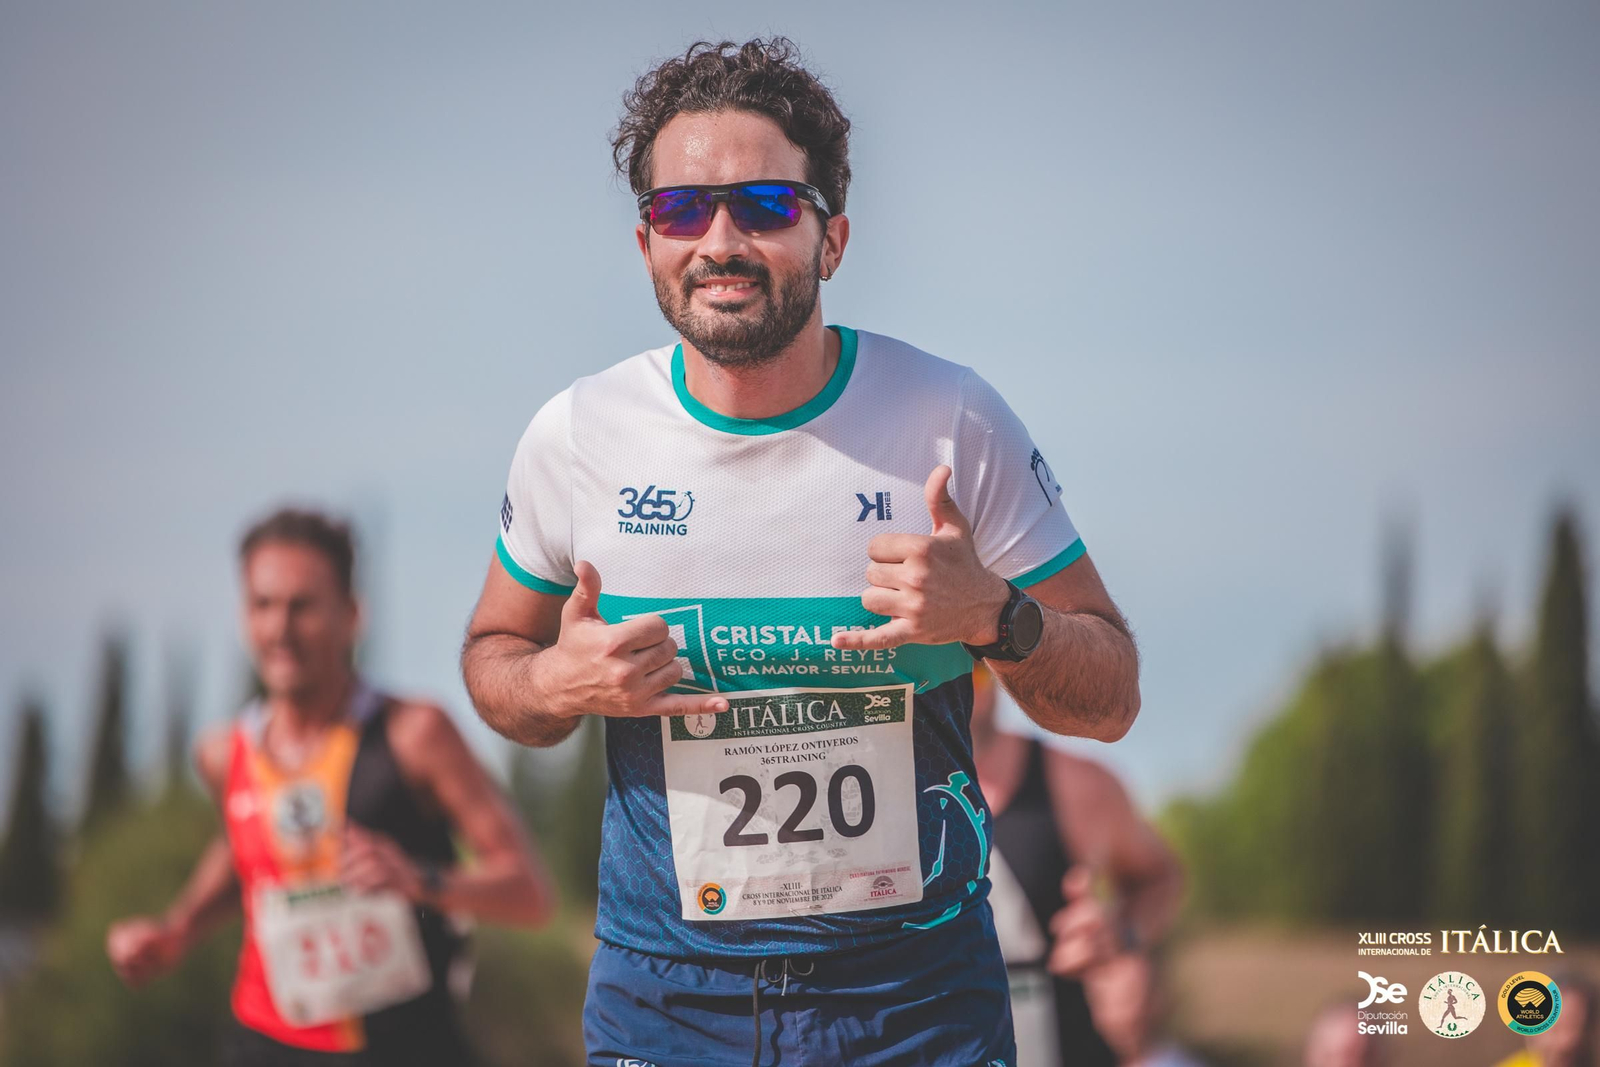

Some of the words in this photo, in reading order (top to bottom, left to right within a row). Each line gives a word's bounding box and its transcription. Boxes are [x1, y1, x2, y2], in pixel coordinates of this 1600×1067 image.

[617, 484, 676, 521] 365
[618, 521, 688, 536] TRAINING
[710, 624, 875, 646] CRISTAL
[717, 648, 775, 662] FCO.
[790, 648, 809, 662] J.
[824, 647, 897, 662] REYES
[722, 664, 759, 676] ISLA
[761, 663, 819, 675] MAYOR
[831, 663, 895, 675] SEVILLA
[732, 698, 847, 730] ITÁLICA
[864, 713, 891, 723] Sevilla
[734, 727, 791, 737] INTERNATIONAL
[792, 725, 815, 733] CROSS
[816, 721, 847, 730] COUNTRY
[724, 743, 763, 756] RAMÓN
[764, 742, 800, 754] LÓPEZ
[801, 736, 859, 751] ONTIVEROS
[760, 751, 827, 766] 365TRAINING
[718, 764, 876, 847] 220
[741, 892, 762, 900] CROSS
[762, 889, 810, 899] INTERNACIONAL
[776, 896, 811, 905] NOVIEMBRE
[821, 893, 834, 901] 2025
